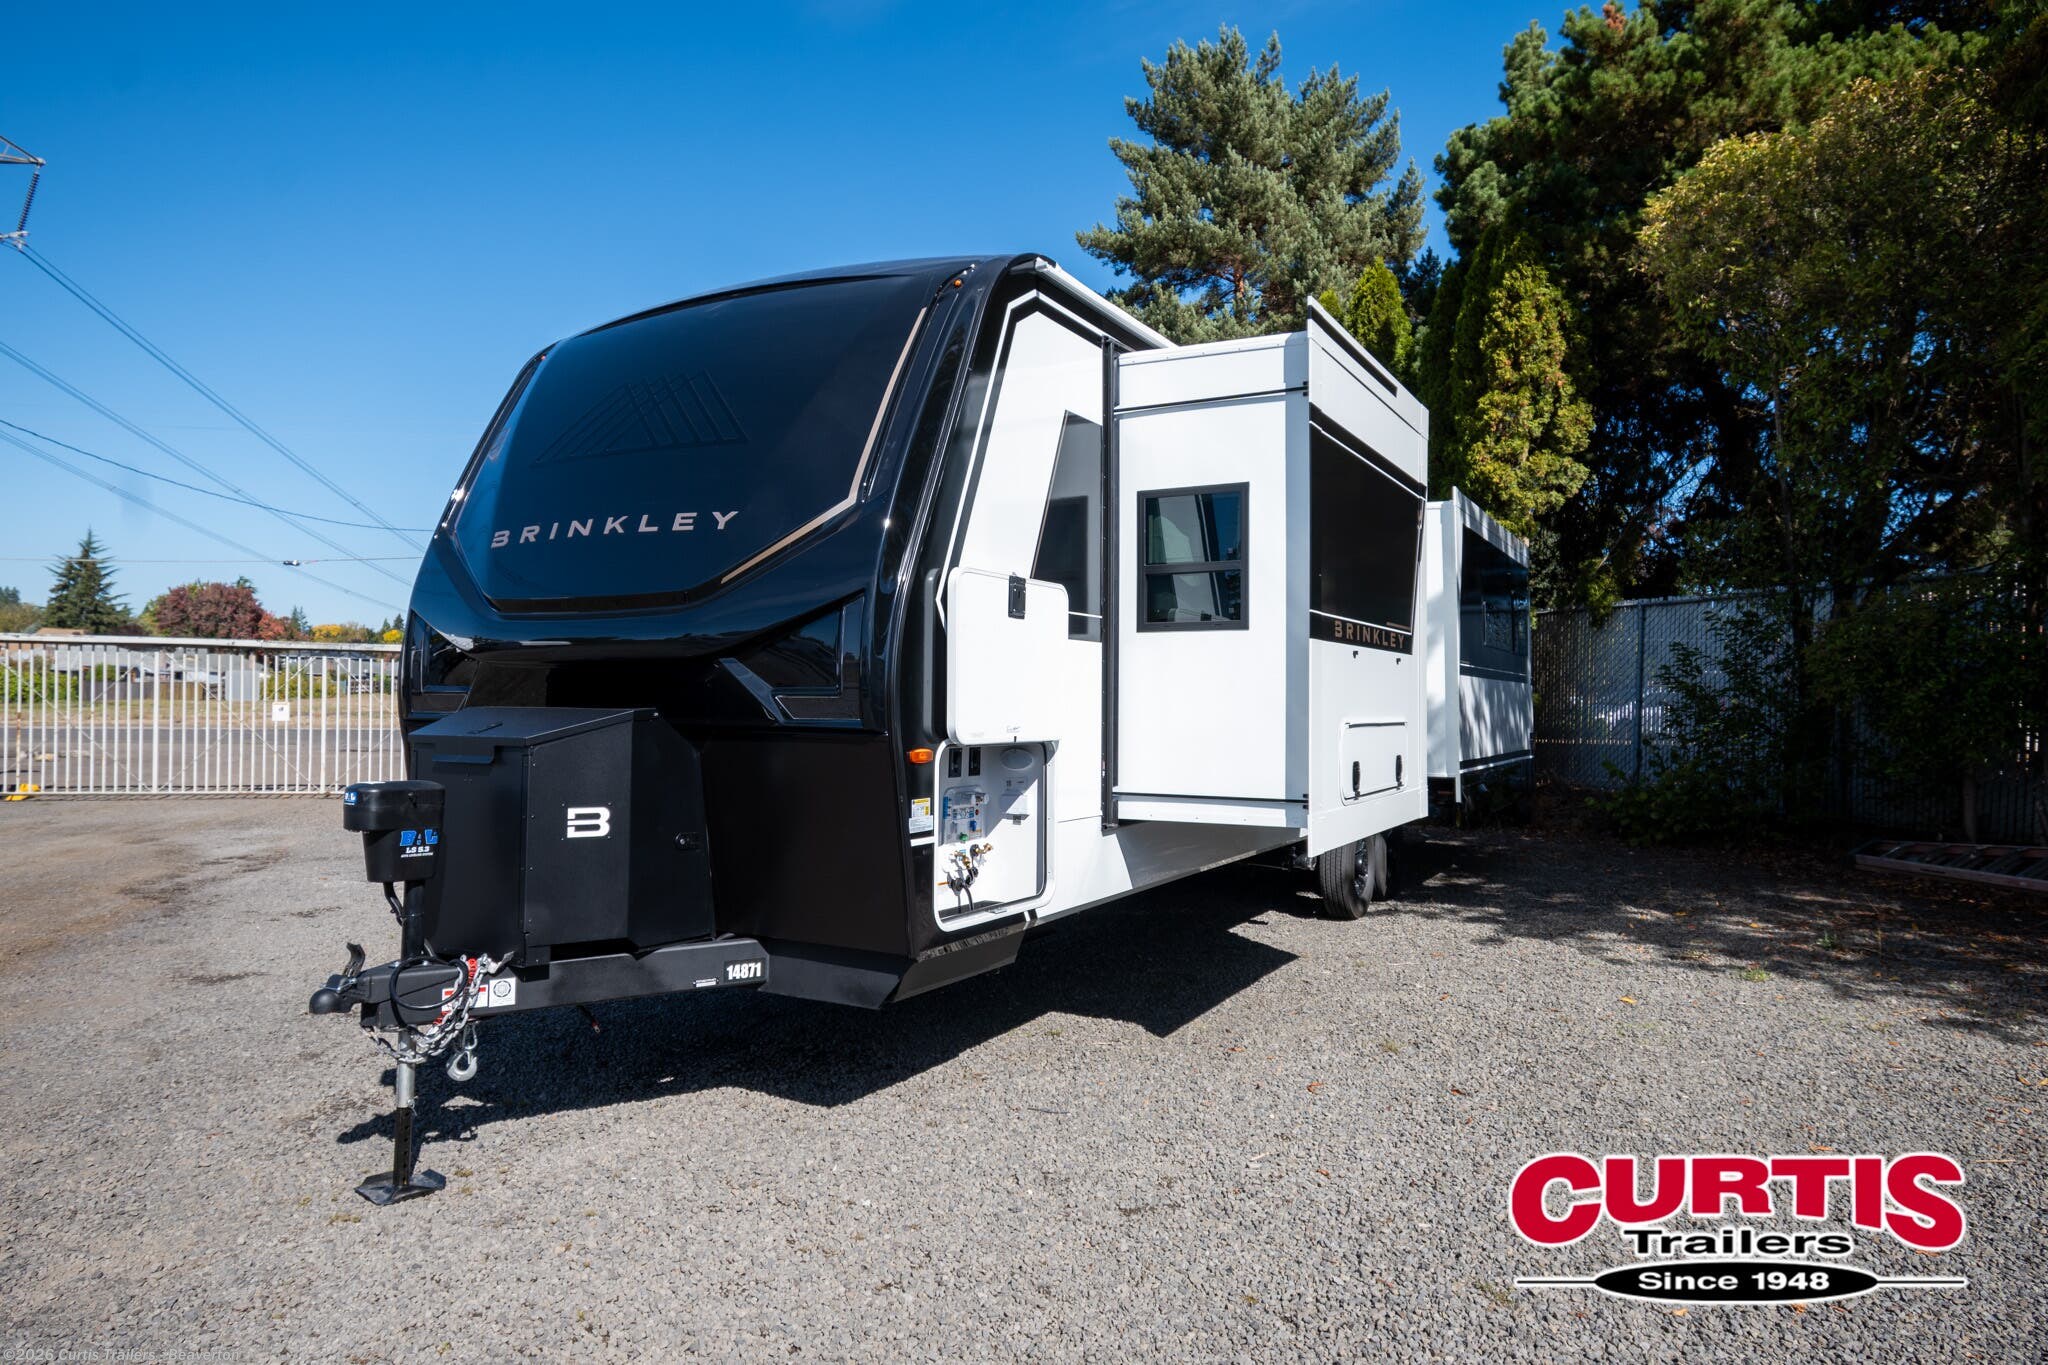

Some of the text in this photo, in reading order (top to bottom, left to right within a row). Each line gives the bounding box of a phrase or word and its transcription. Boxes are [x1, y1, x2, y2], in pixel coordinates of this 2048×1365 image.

[490, 510, 739, 549] BRINKLEY
[1334, 620, 1405, 649] BRINKLEY
[726, 961, 762, 981] 14871
